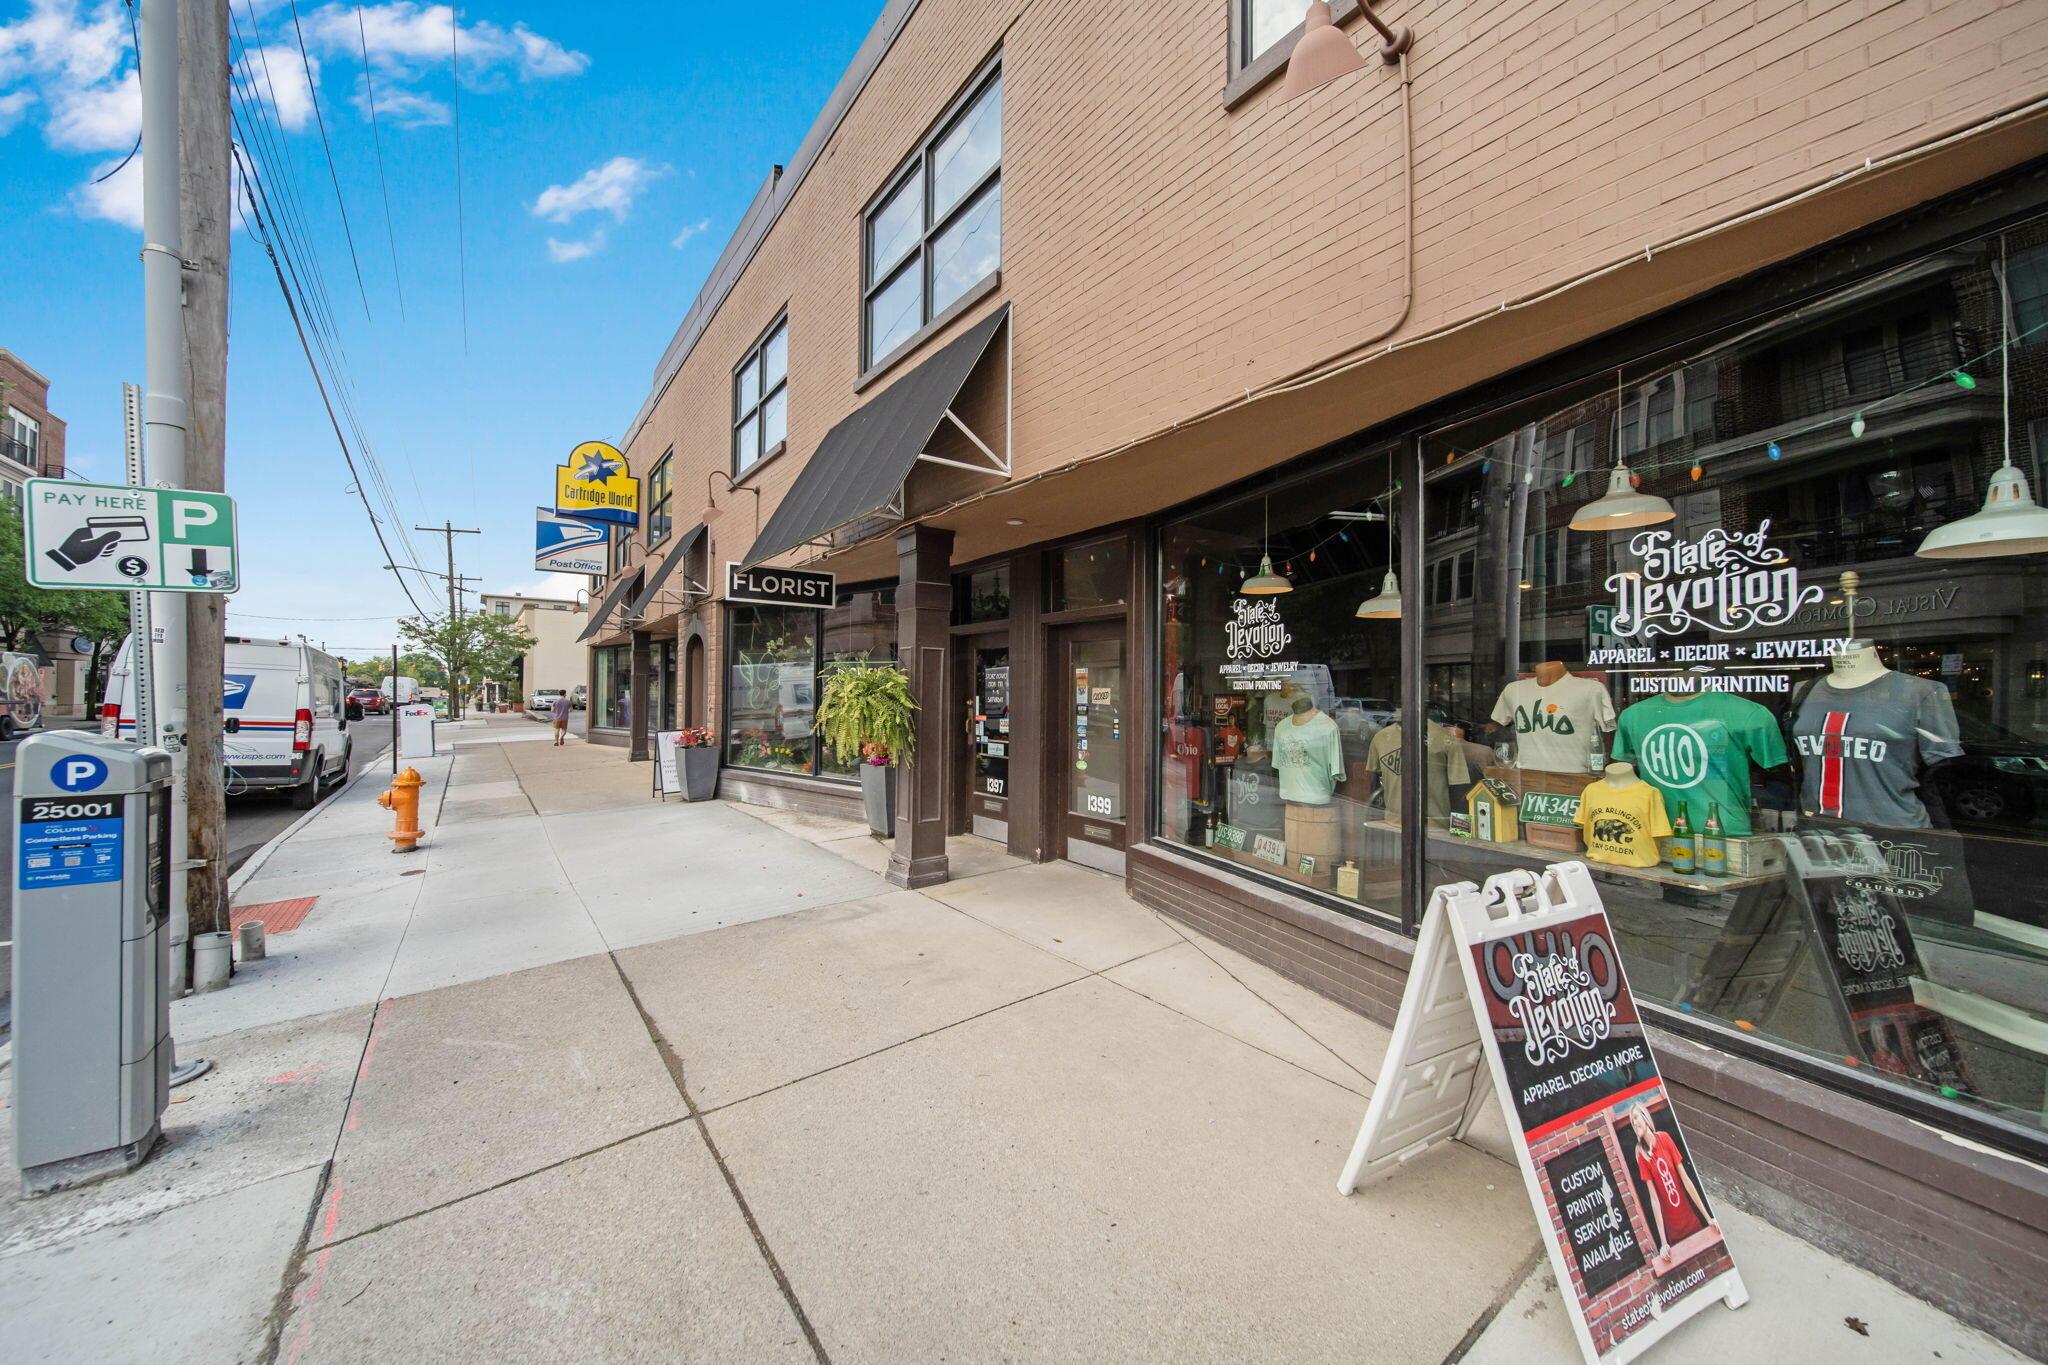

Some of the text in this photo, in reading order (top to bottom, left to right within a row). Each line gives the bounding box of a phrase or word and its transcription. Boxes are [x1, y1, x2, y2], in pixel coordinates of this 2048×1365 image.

[43, 491, 148, 511] PAY HERE
[564, 484, 633, 508] Cartridge World
[171, 499, 219, 539] P
[1629, 518, 1771, 581] State of
[549, 558, 572, 569] Post
[573, 560, 602, 572] Office
[733, 572, 830, 598] FLORIST
[1232, 597, 1278, 628] State of
[1604, 565, 1824, 638] Devotion
[1225, 620, 1292, 659] Devotion
[1587, 637, 1852, 665] APPAREL DECOR JEWELRY
[1219, 661, 1299, 674] APPAREL DECOR JEWELRY
[1233, 681, 1282, 690] CUSTOM PRINTING
[1630, 674, 1790, 693] CUSTOM PRINTING
[405, 709, 431, 717] FedEx
[1514, 698, 1576, 735] Ohio
[1650, 731, 1696, 781] HIO
[1795, 735, 1888, 763] EVOTED
[66, 760, 96, 787] P
[986, 777, 1004, 794] 1397
[32, 803, 113, 820] 25001
[1087, 795, 1112, 815] 1399
[1605, 807, 1643, 831] ARLINGTON
[25, 835, 82, 844] Contactless
[1604, 842, 1635, 856] GOLDEN
[1845, 880, 1925, 899] COLUMBUS
[1511, 946, 1580, 1004] State of
[1508, 984, 1617, 1067] Devotion
[1522, 1075, 1572, 1106] APPAREL,
[1570, 1060, 1606, 1086] DECOR
[1613, 1044, 1645, 1068] MORE
[1560, 1161, 1605, 1194] CUSTOM
[1566, 1180, 1613, 1220] PRINTIN
[1573, 1206, 1623, 1245] SERVICS
